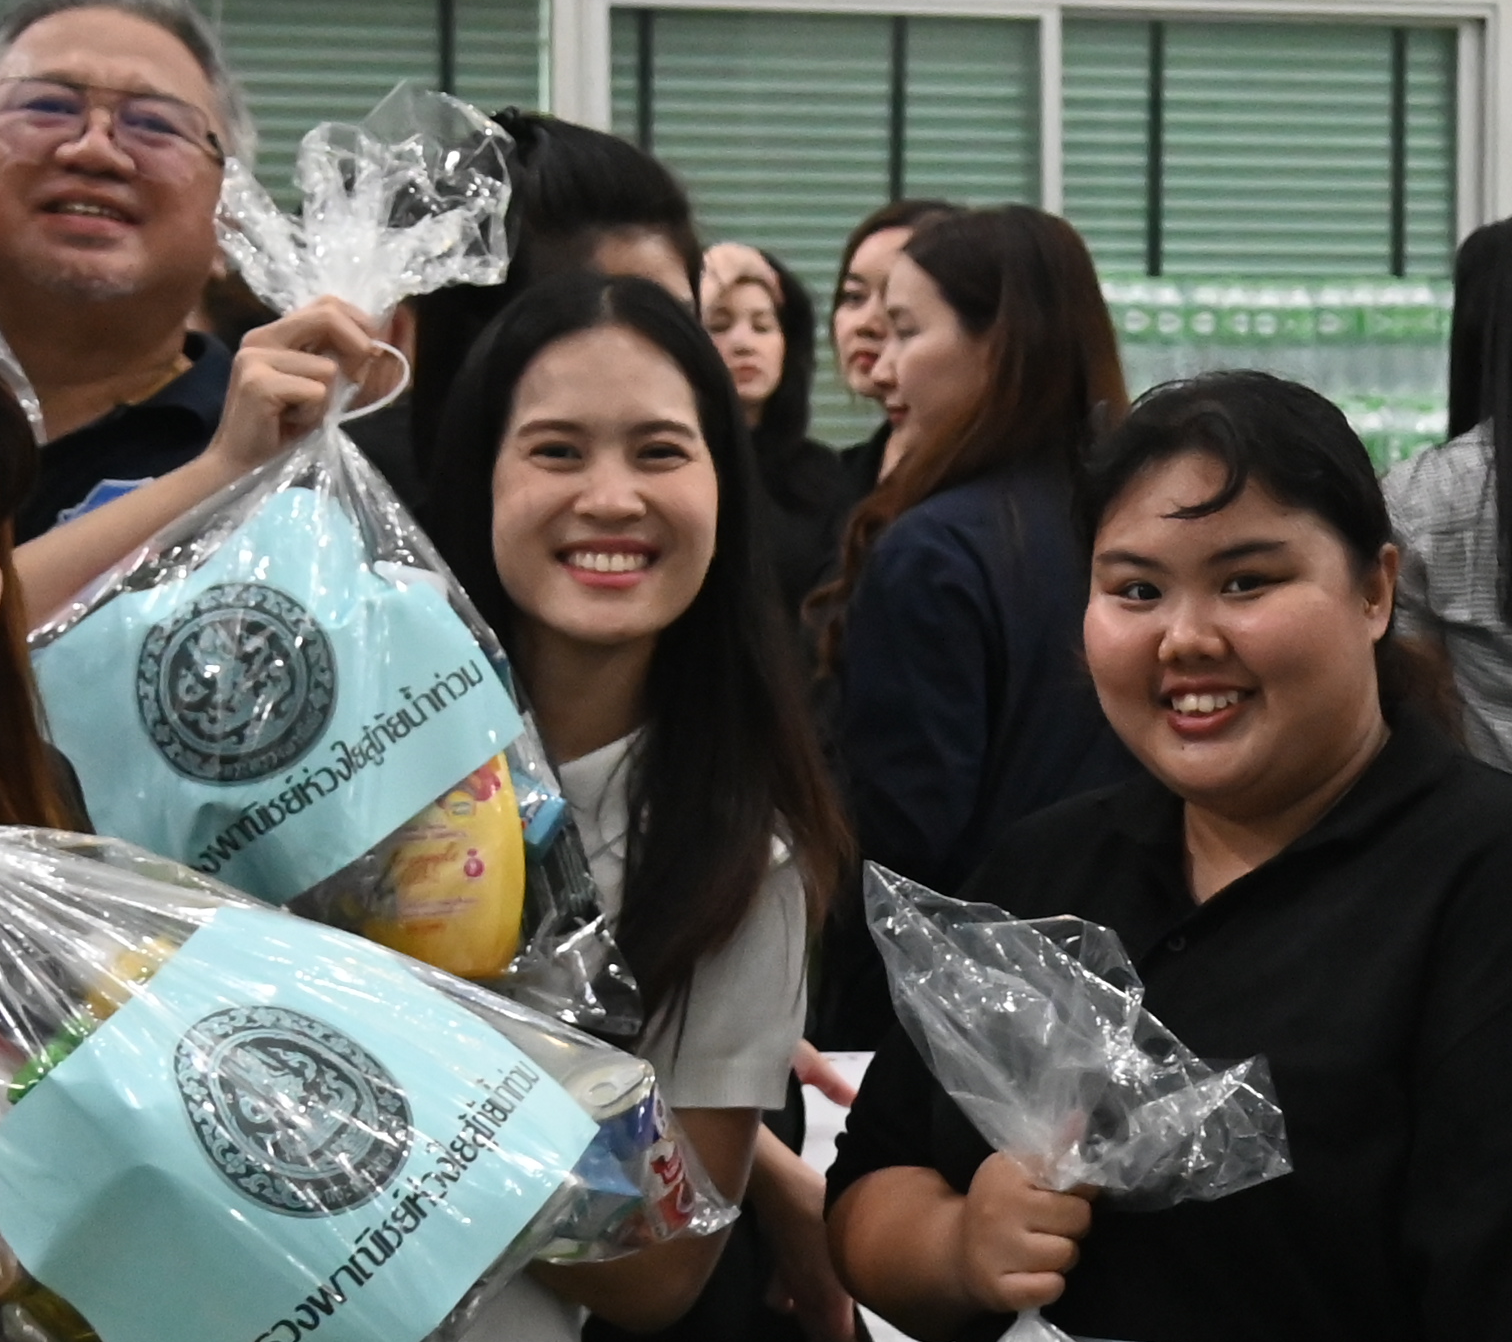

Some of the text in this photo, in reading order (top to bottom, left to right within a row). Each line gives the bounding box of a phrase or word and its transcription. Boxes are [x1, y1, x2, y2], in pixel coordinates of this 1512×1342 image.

[191, 655, 483, 876] งพาณิชย์ห่วงใยสู้ภัยน้ำท่วม
